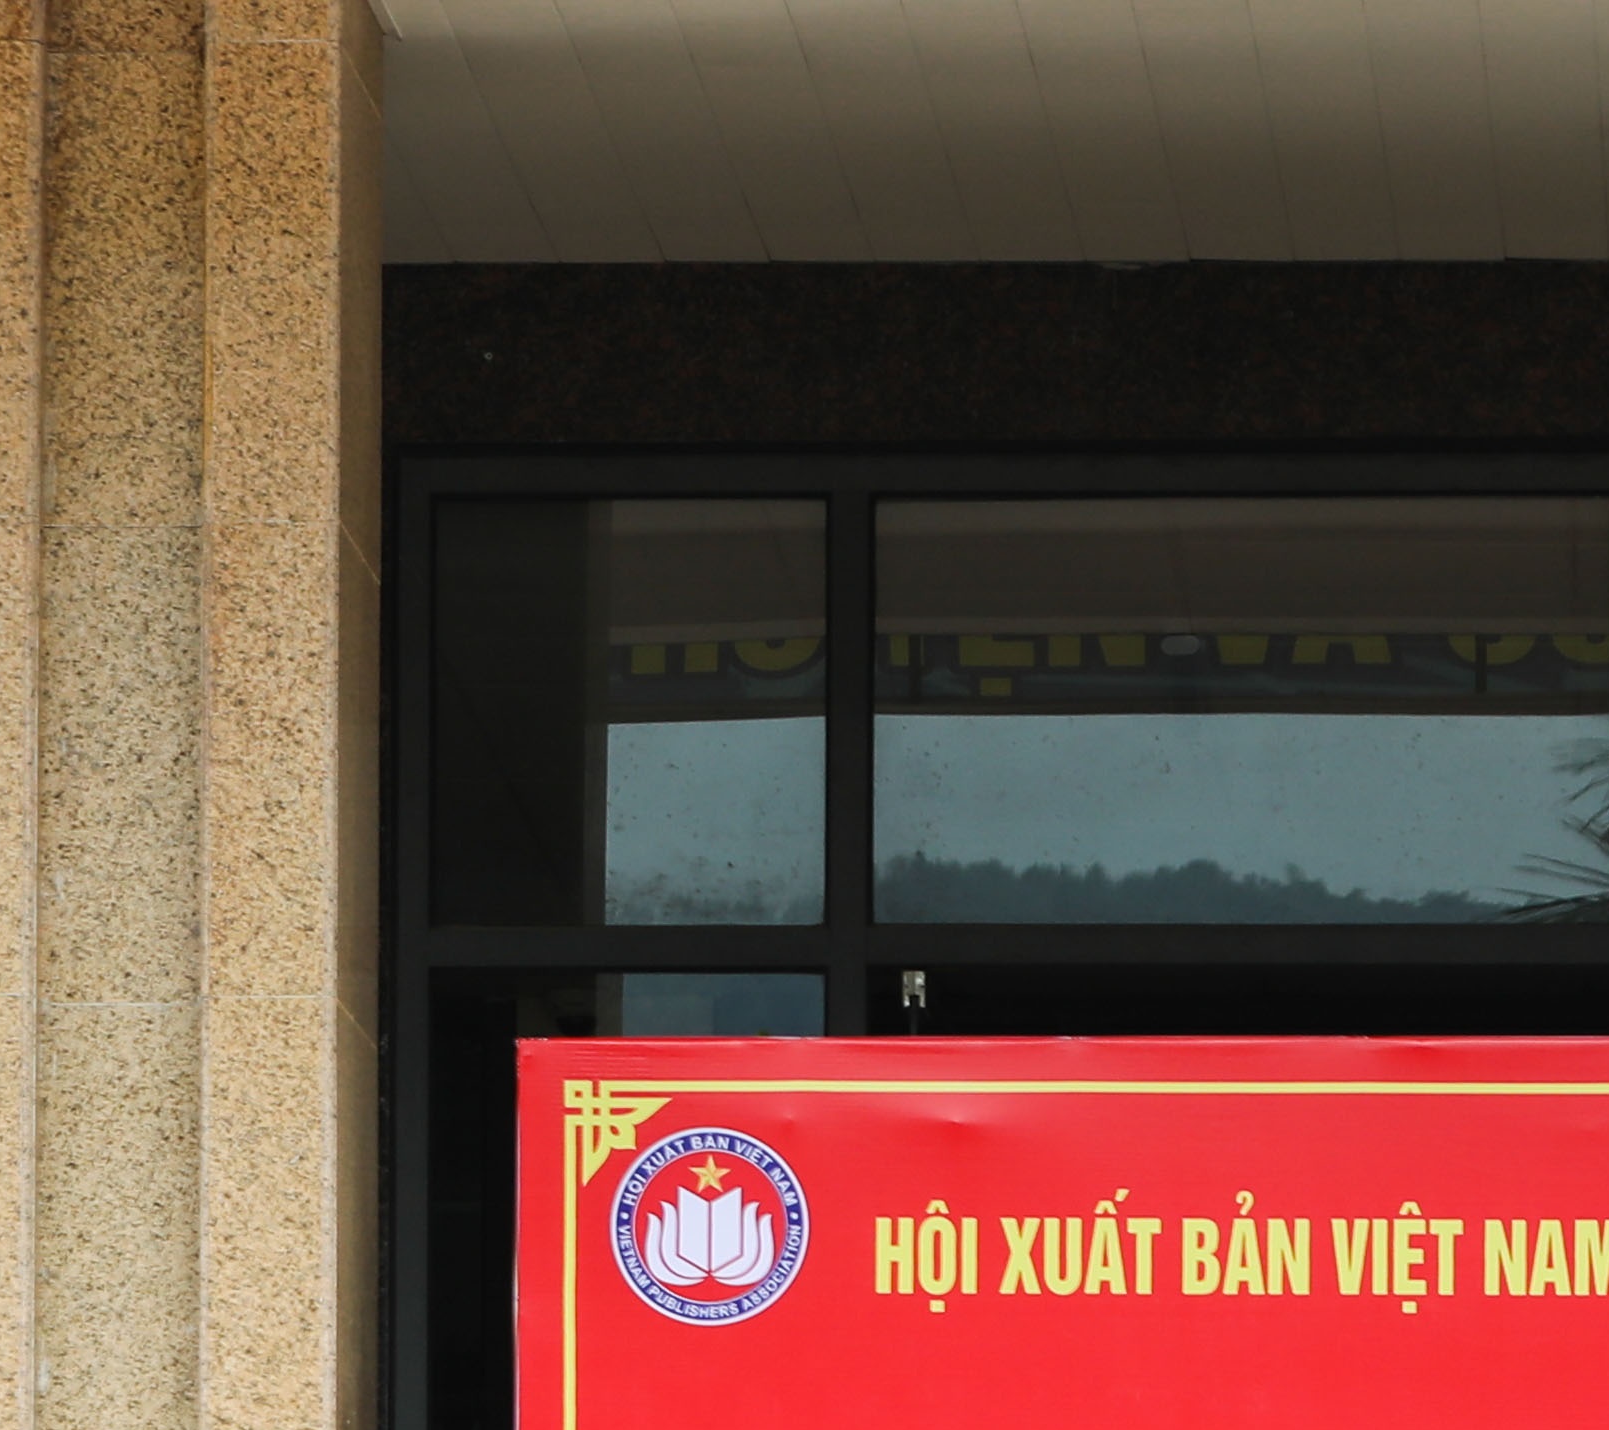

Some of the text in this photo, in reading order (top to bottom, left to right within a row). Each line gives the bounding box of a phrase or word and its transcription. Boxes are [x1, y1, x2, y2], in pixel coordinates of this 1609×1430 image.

[618, 1223, 803, 1319] VIETNAM PUBLISHERS ASSOCIATION
[876, 1200, 978, 1313] HỘI
[1000, 1189, 1162, 1295] XUẤT
[1185, 1191, 1310, 1295] BẢN
[1332, 1202, 1464, 1313] VIỆT
